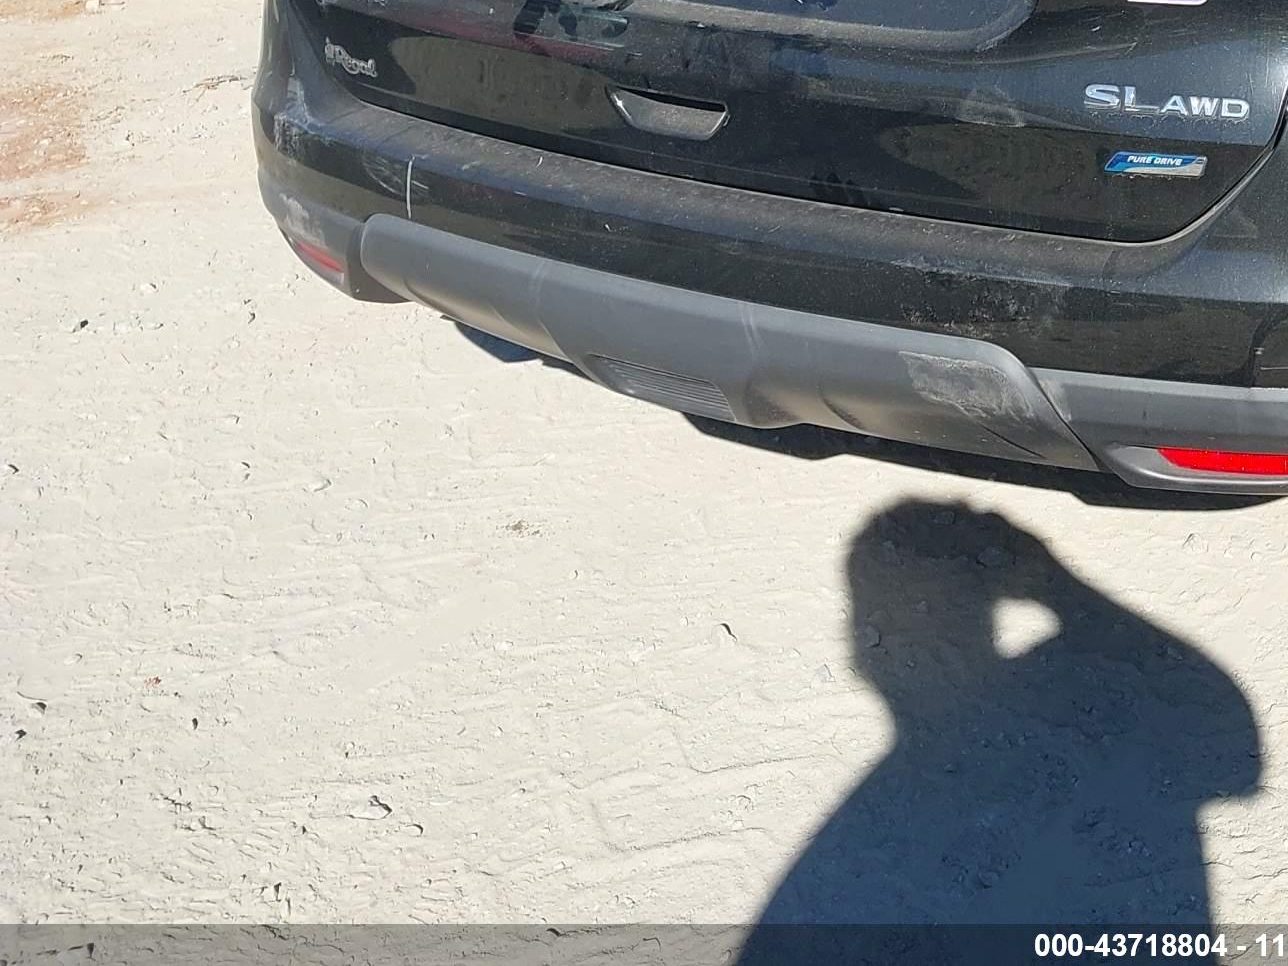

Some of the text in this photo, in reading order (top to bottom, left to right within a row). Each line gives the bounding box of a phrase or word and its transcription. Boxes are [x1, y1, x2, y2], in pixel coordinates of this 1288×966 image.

[1084, 84, 1250, 119] SL AWD
[1127, 155, 1183, 166] PURE DRIVE
